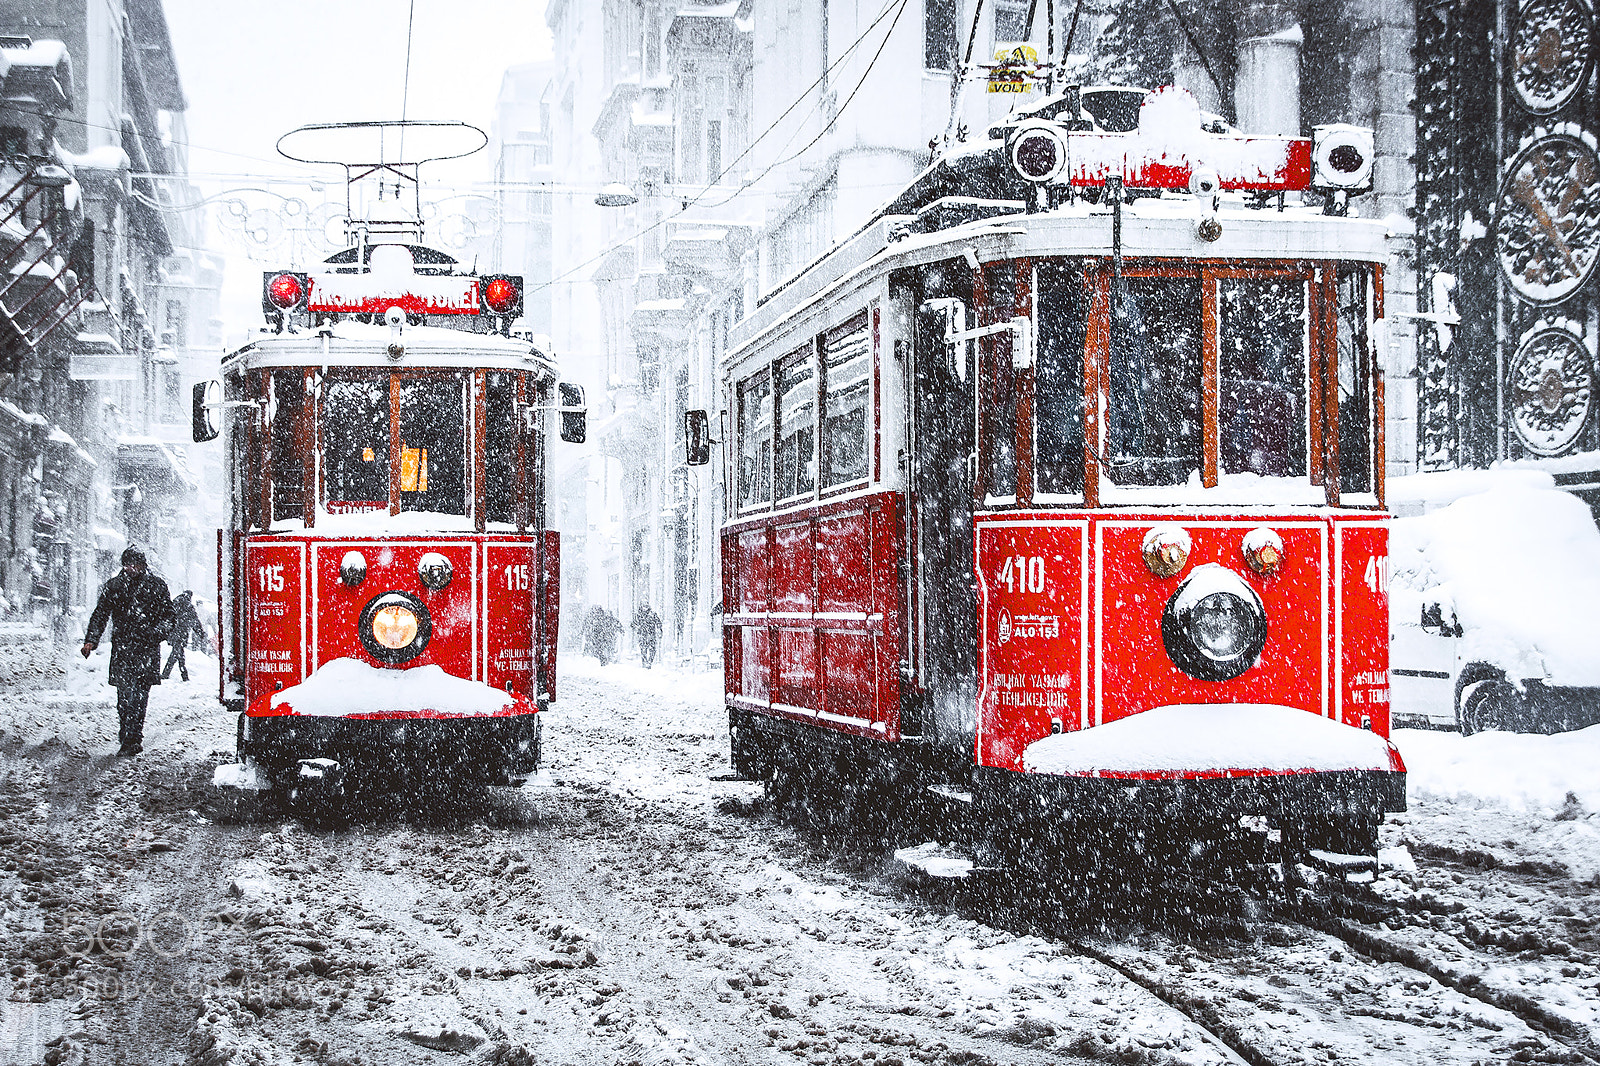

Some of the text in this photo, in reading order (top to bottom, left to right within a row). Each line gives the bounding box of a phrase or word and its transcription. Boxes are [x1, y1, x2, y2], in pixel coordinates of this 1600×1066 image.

[994, 83, 1027, 92] VOLT
[259, 564, 284, 592] 115
[505, 564, 528, 591] 115
[1001, 555, 1045, 593] 410
[1014, 626, 1035, 638] ALO
[1038, 626, 1059, 638] 153
